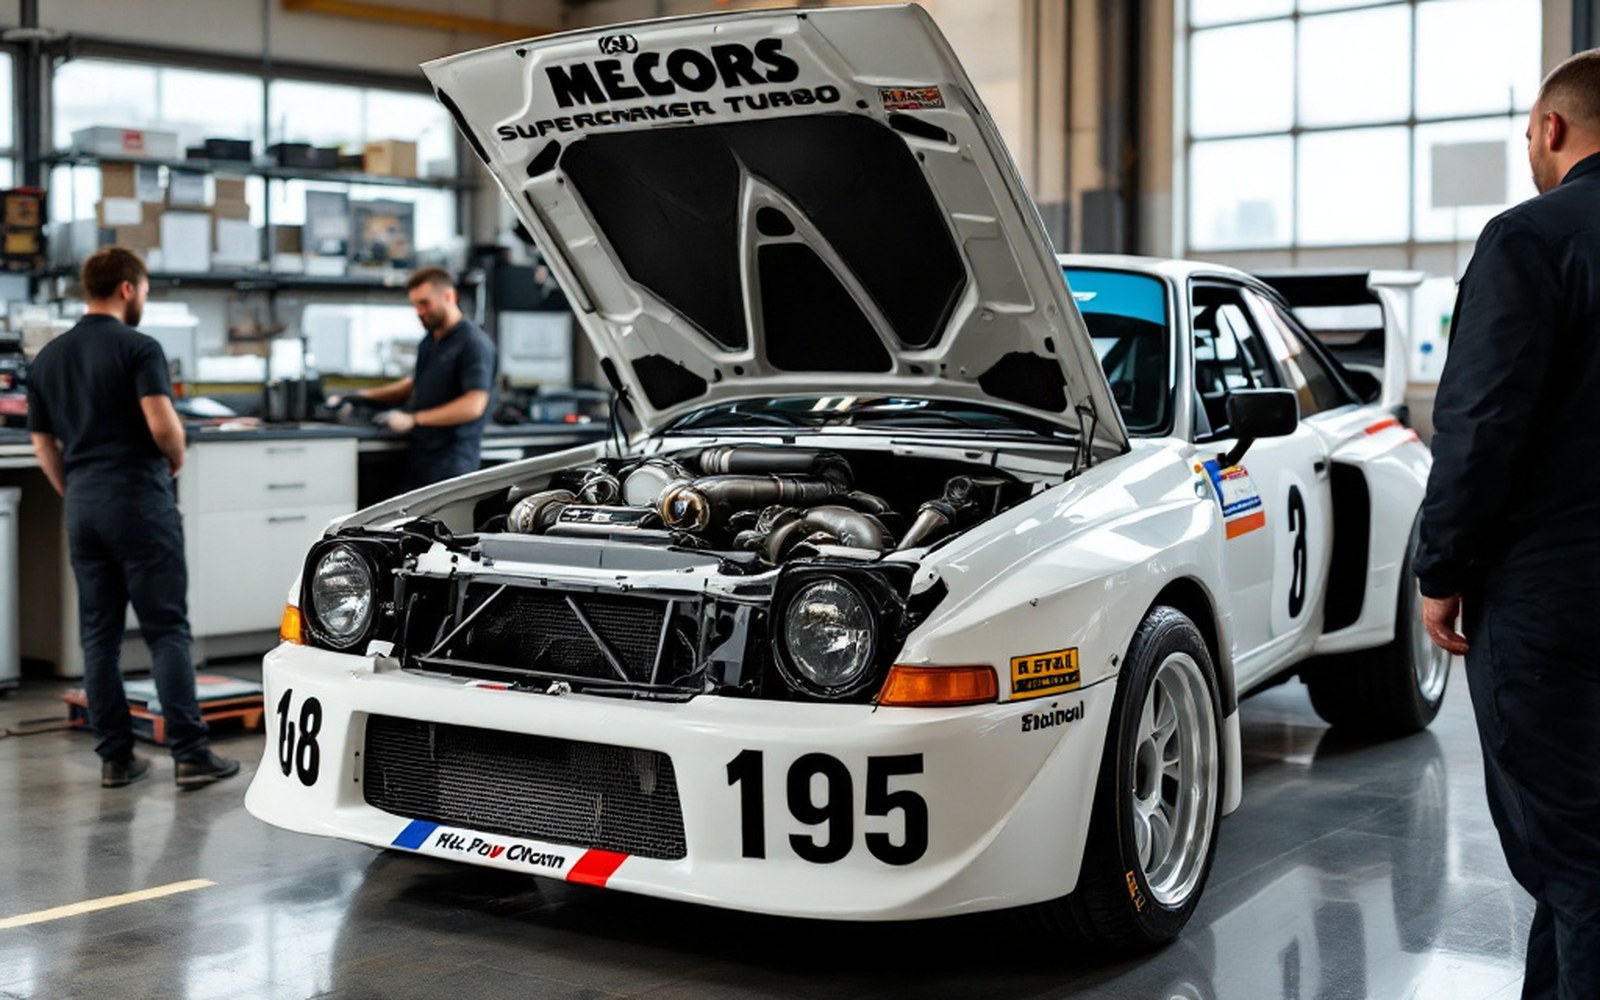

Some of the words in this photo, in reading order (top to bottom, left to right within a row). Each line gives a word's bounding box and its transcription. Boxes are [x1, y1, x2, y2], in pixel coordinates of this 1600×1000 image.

[545, 38, 799, 108] MECORS
[723, 85, 840, 113] TURBO
[726, 749, 929, 866] 195
